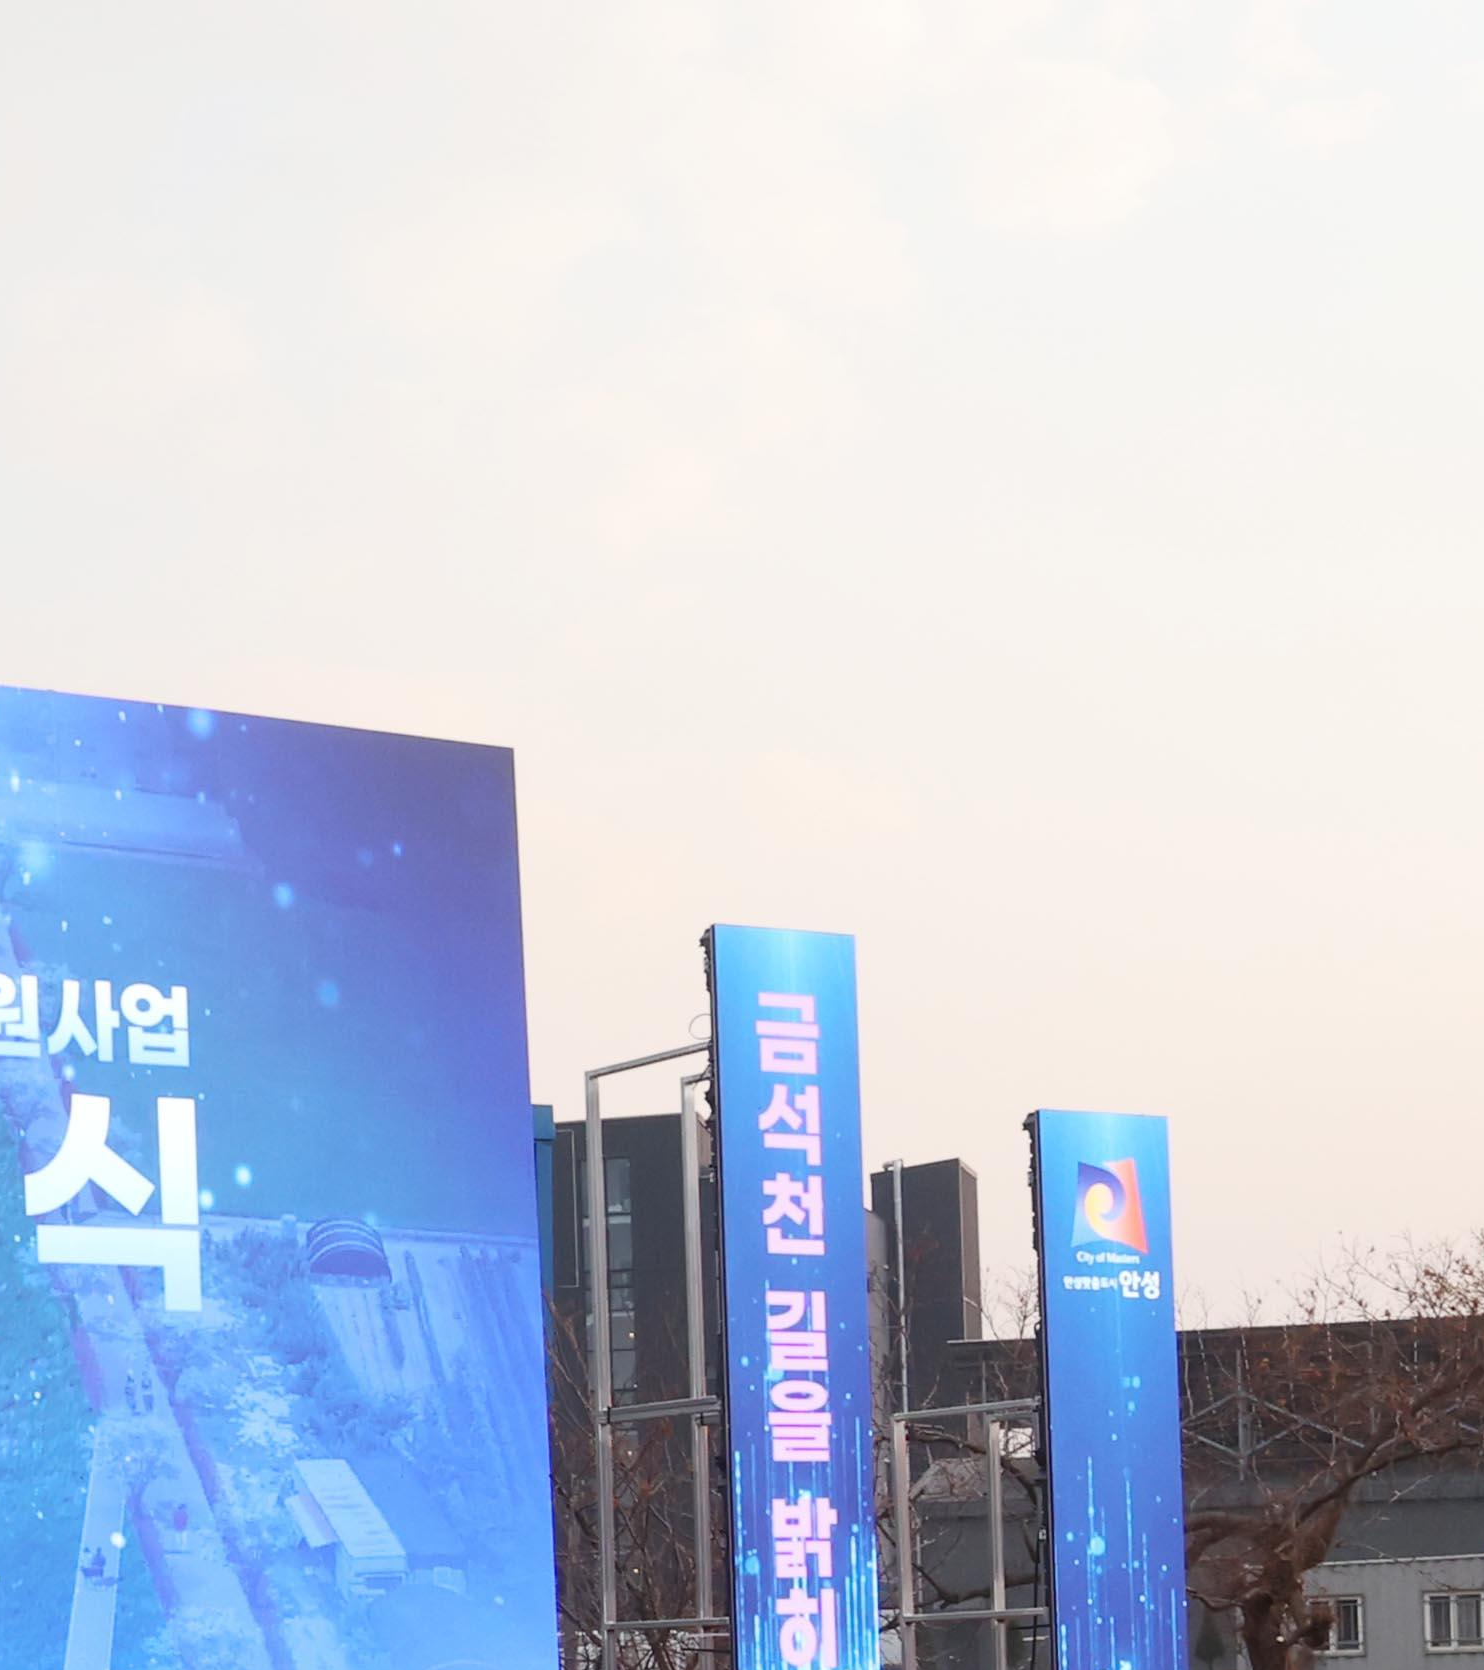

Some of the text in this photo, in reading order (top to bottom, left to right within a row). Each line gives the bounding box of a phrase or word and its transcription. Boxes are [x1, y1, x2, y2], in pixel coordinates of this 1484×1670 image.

[754, 990, 824, 1258] 금석천
[1118, 1270, 1160, 1299] 안성
[765, 1289, 831, 1463] 길을
